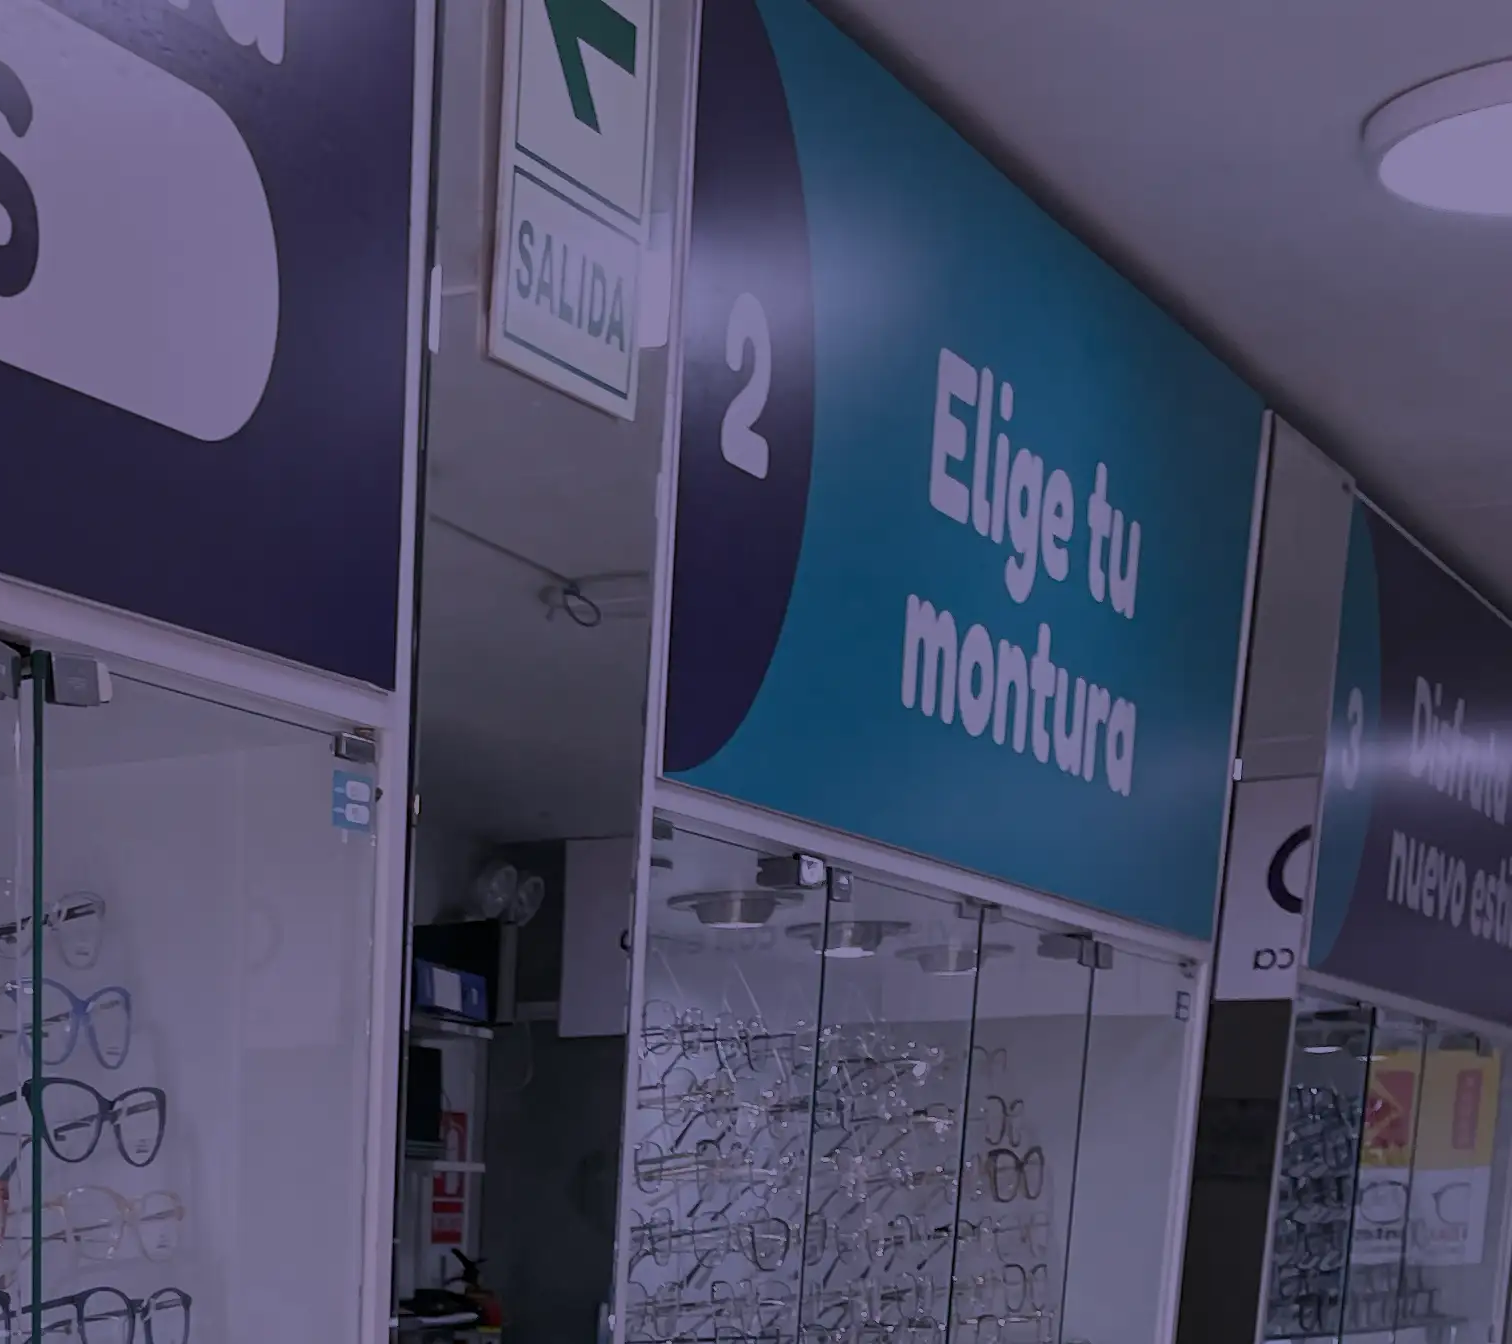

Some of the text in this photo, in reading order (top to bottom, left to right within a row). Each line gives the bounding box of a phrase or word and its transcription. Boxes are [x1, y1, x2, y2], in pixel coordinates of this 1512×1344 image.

[516, 220, 625, 352] SALIDA
[720, 292, 773, 480] 2
[930, 346, 1141, 619] Elige tu
[901, 593, 1136, 797] montura
[1342, 687, 1364, 790] 3
[1387, 828, 1467, 928] nuevo
